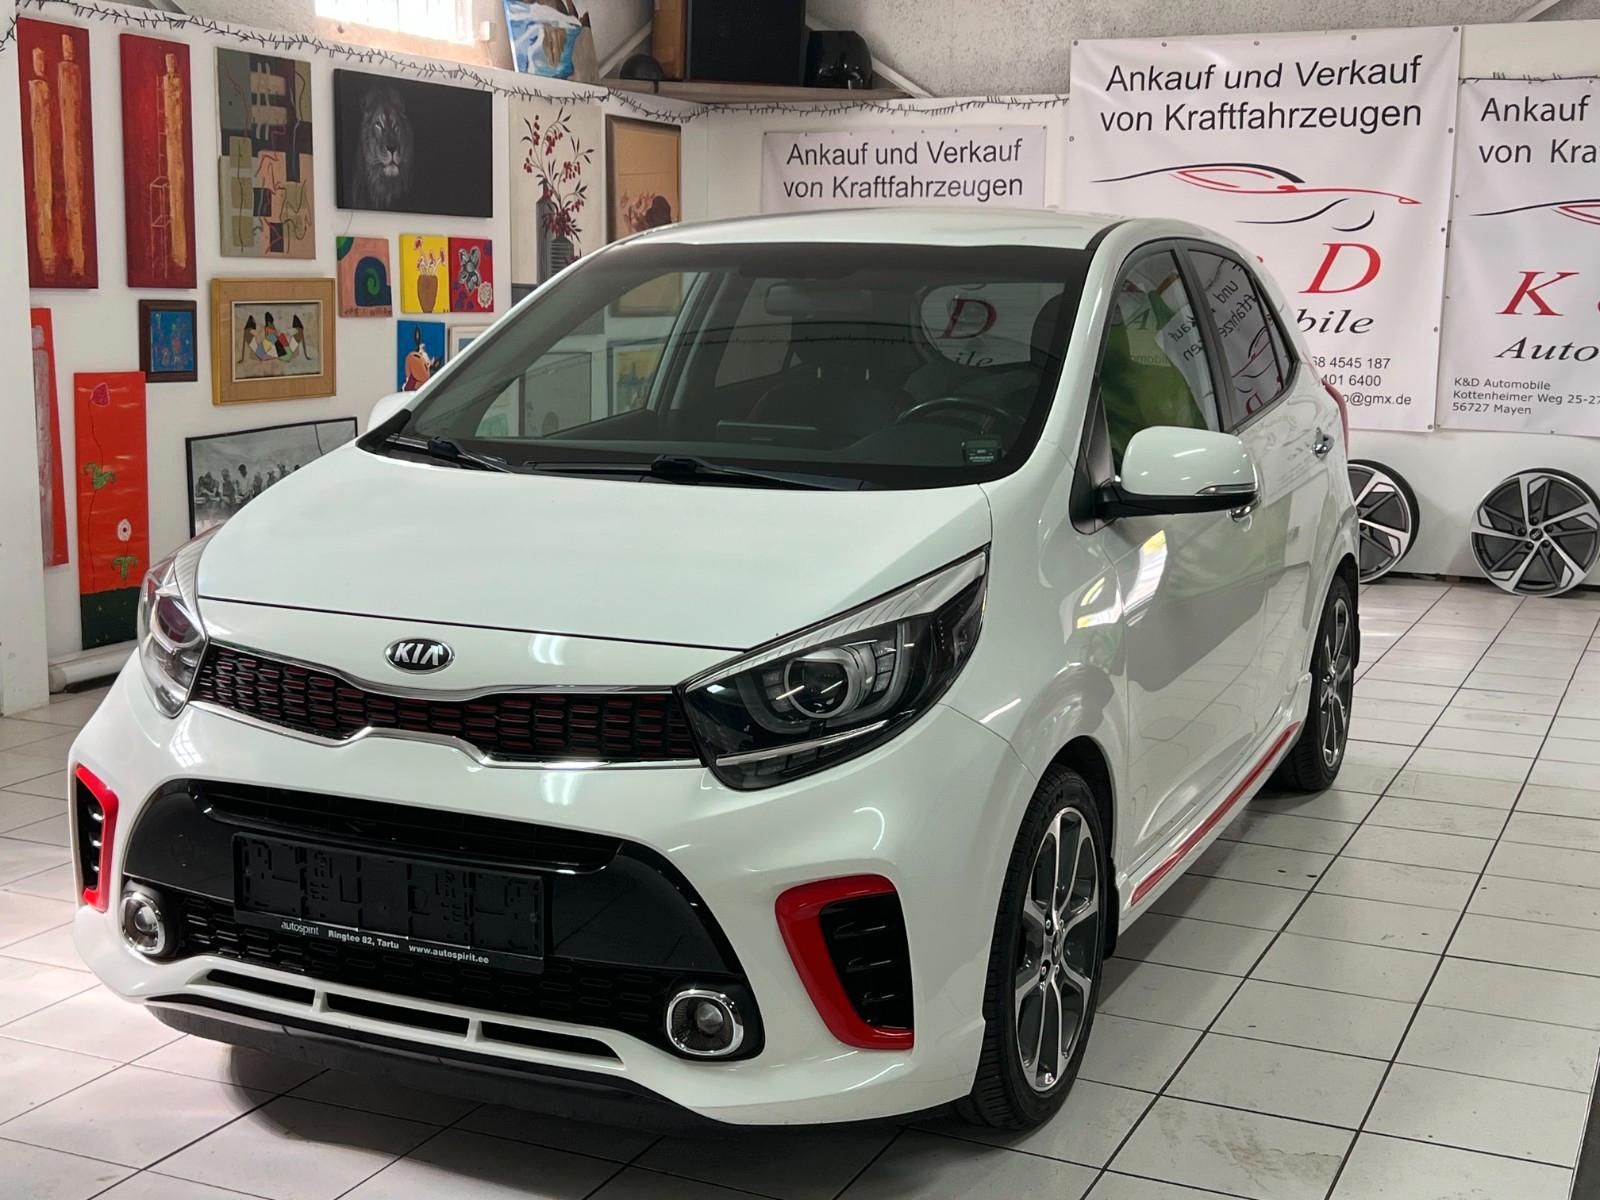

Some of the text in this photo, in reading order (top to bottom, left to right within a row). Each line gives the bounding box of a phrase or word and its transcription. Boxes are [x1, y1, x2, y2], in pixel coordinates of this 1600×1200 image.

[1105, 54, 1423, 92] Ankauf und Verkauf
[1099, 101, 1422, 135] von Kraftfahrzeugen
[1480, 94, 1592, 122] Ankauf
[786, 138, 1023, 166] Ankauf und Verkauf
[1478, 144, 1532, 164] von
[783, 175, 1023, 202] von Kraftfahrzeugen
[1297, 242, 1381, 294] D
[1495, 270, 1580, 317] K
[1493, 336, 1600, 362] Auto
[1329, 356, 1362, 369] 4545
[1367, 357, 1391, 370] 187
[1348, 374, 1382, 387] 6400
[1454, 377, 1551, 391] K&D Automobile
[1452, 401, 1532, 416] 56727 Mayen
[1453, 390, 1533, 402] Kottenheimer
[1537, 393, 1563, 406] Weg
[393, 642, 444, 666] KIA
[376, 938, 400, 950] Tartu
